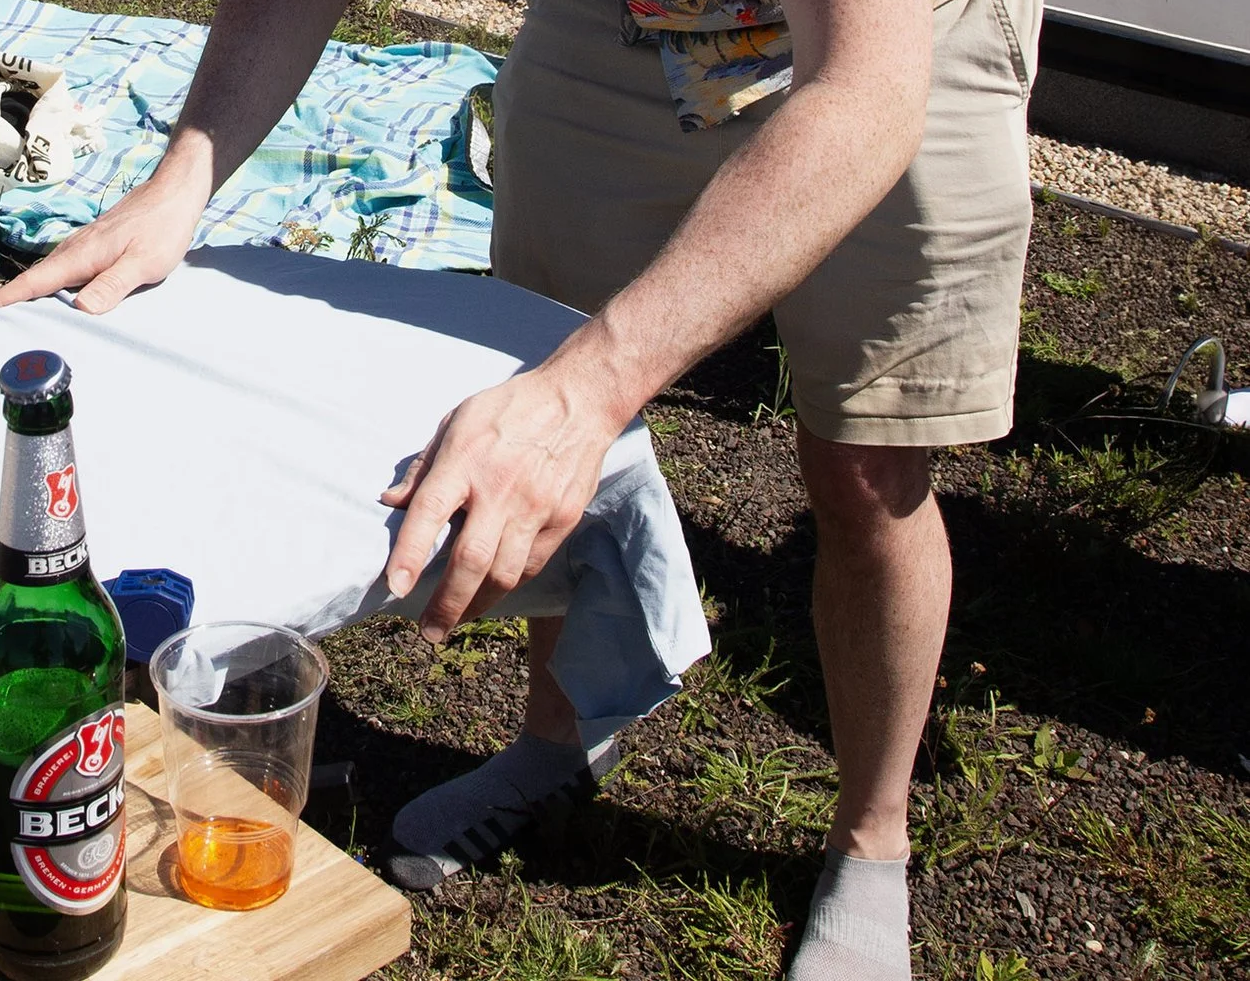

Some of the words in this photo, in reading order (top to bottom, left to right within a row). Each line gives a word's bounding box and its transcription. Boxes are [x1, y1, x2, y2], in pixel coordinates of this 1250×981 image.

[33, 750, 74, 796] BRAUEREI
[34, 854, 68, 890] BREMEN
[73, 868, 116, 895] GERMANY
